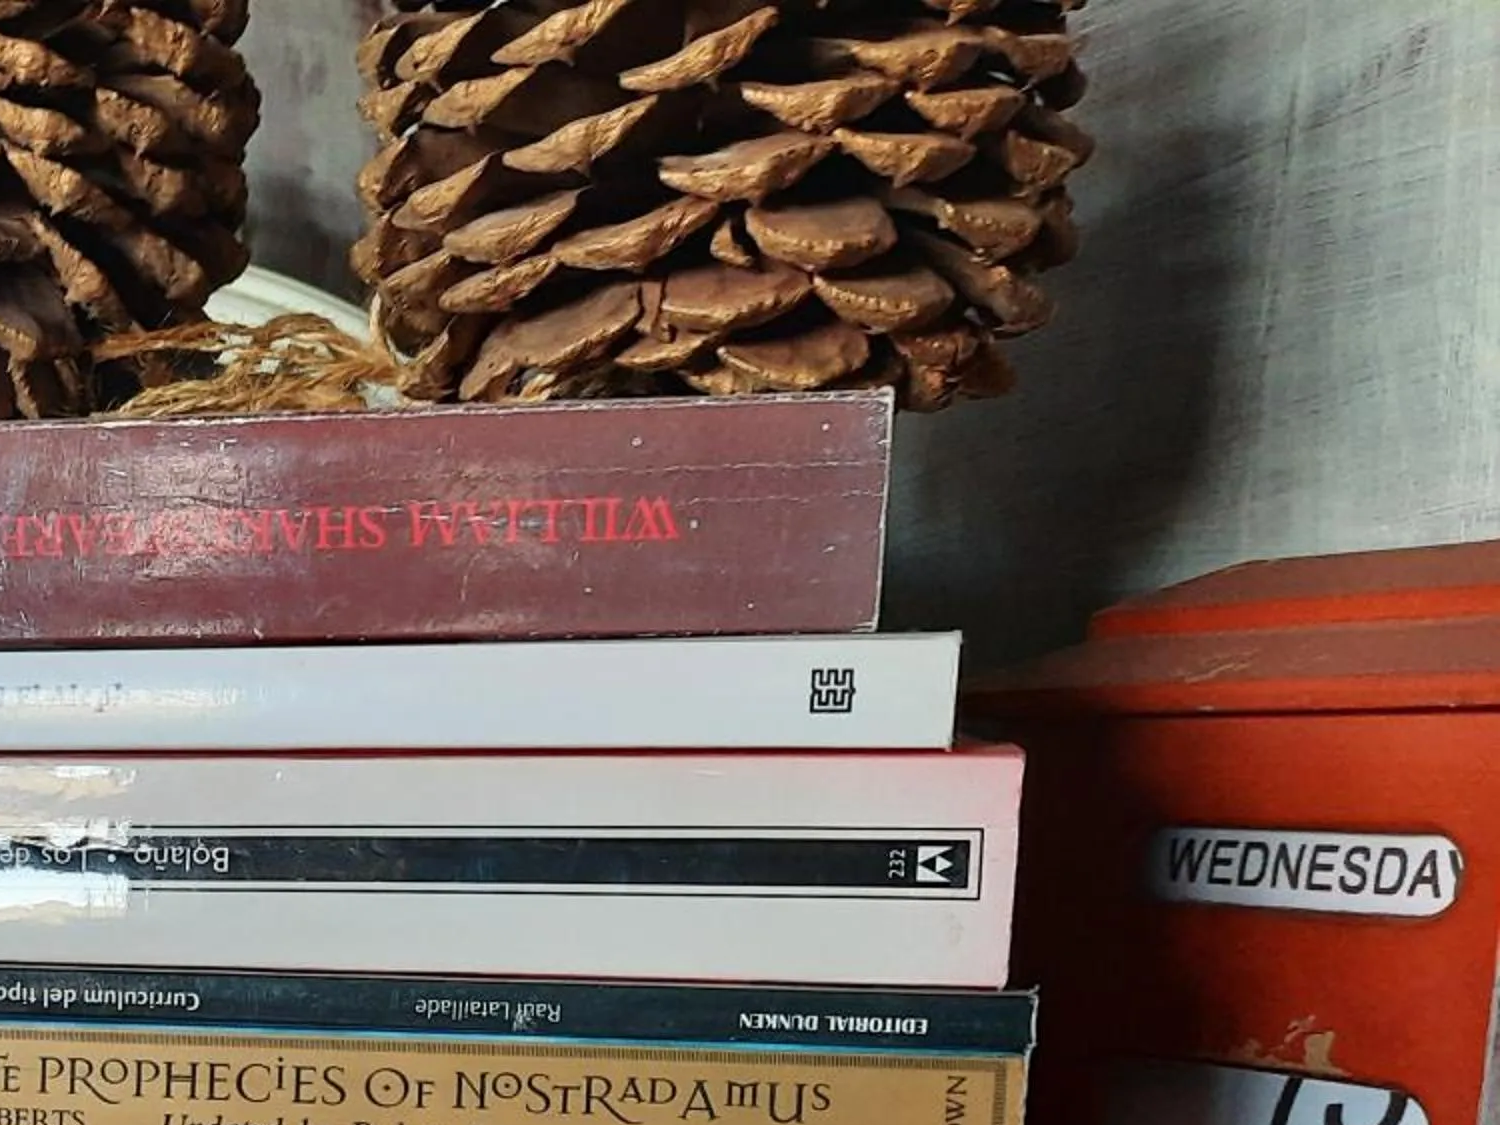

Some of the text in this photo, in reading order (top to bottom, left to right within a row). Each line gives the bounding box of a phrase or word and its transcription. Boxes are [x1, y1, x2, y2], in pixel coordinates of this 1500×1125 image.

[407, 494, 679, 547] WILLIAM
[134, 842, 230, 874] Bolaño
[888, 849, 906, 879] 232
[41, 981, 78, 1005] del
[82, 983, 201, 1011] Curriculum
[739, 1010, 929, 1035] EDITORIAL DUNKEN
